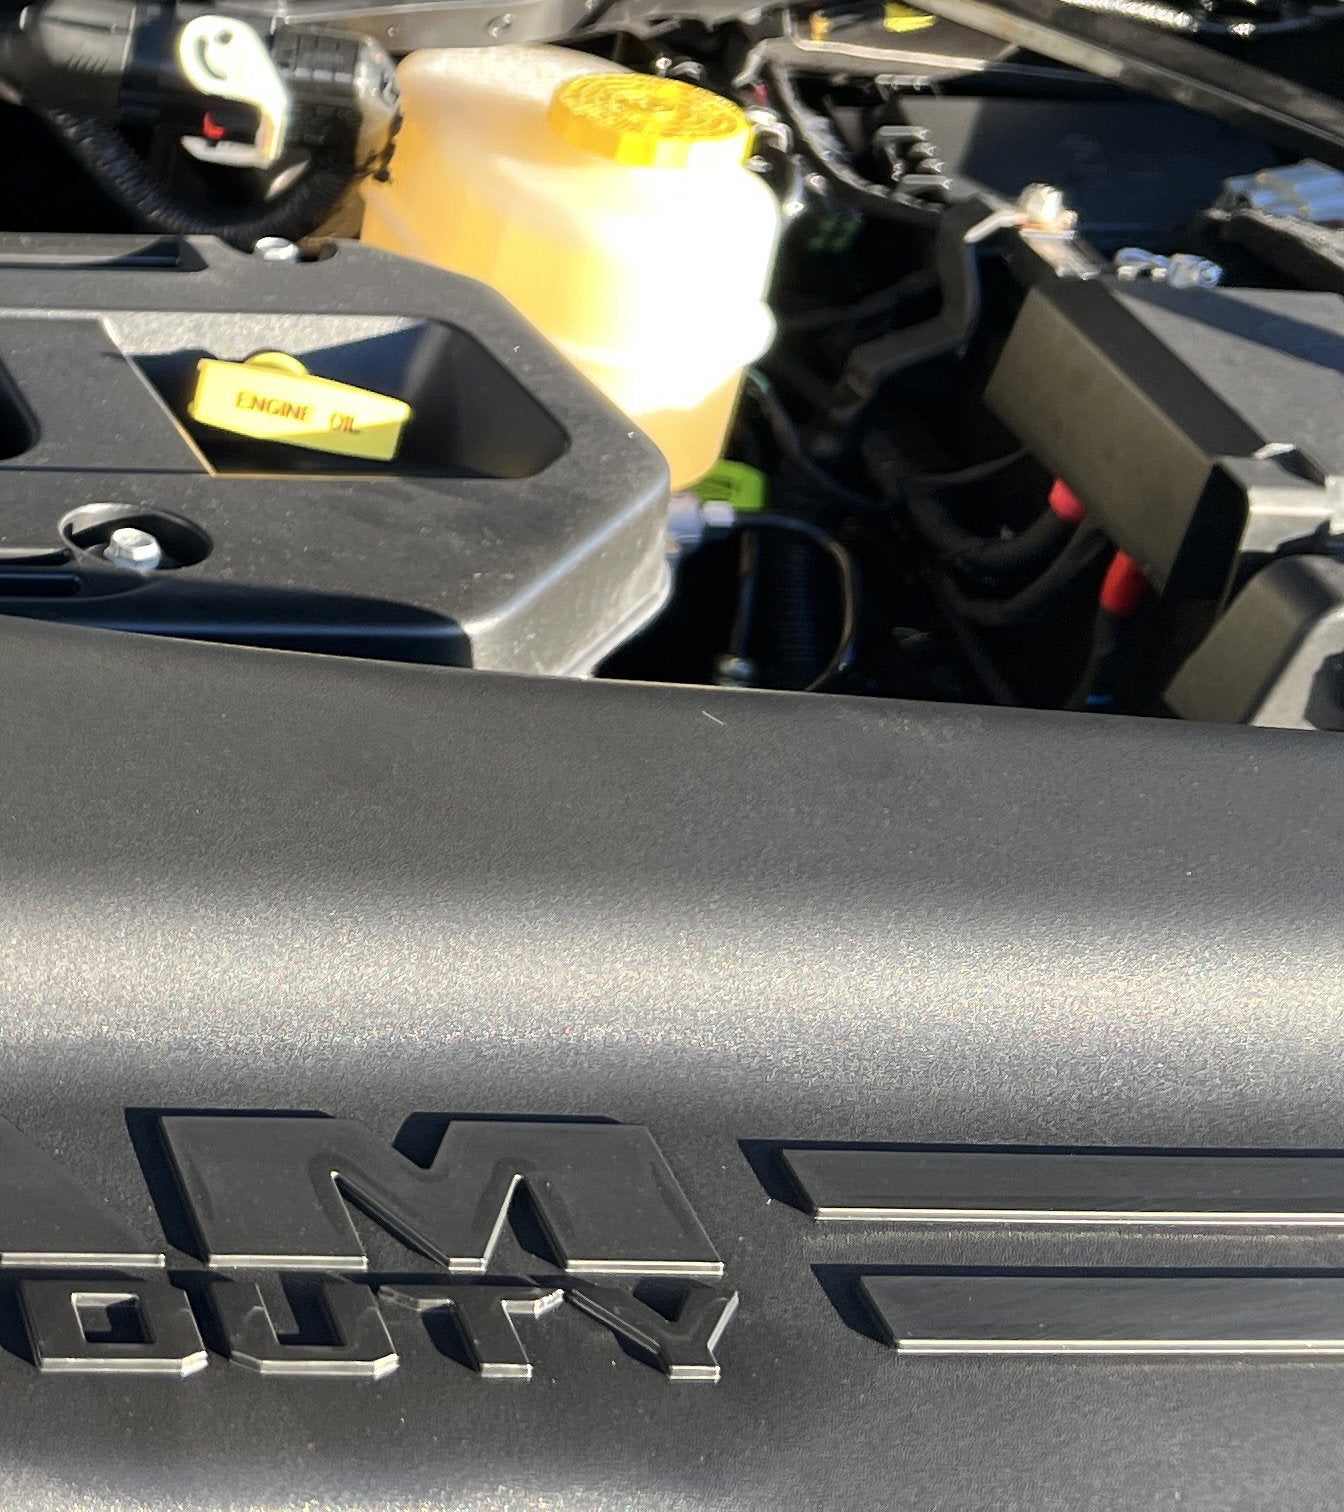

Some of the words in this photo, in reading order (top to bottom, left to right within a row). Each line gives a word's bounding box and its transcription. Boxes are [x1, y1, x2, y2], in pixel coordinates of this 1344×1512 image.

[235, 391, 311, 422] ENGINE
[329, 412, 362, 435] OIL
[2, 1272, 740, 1381] DUTY
